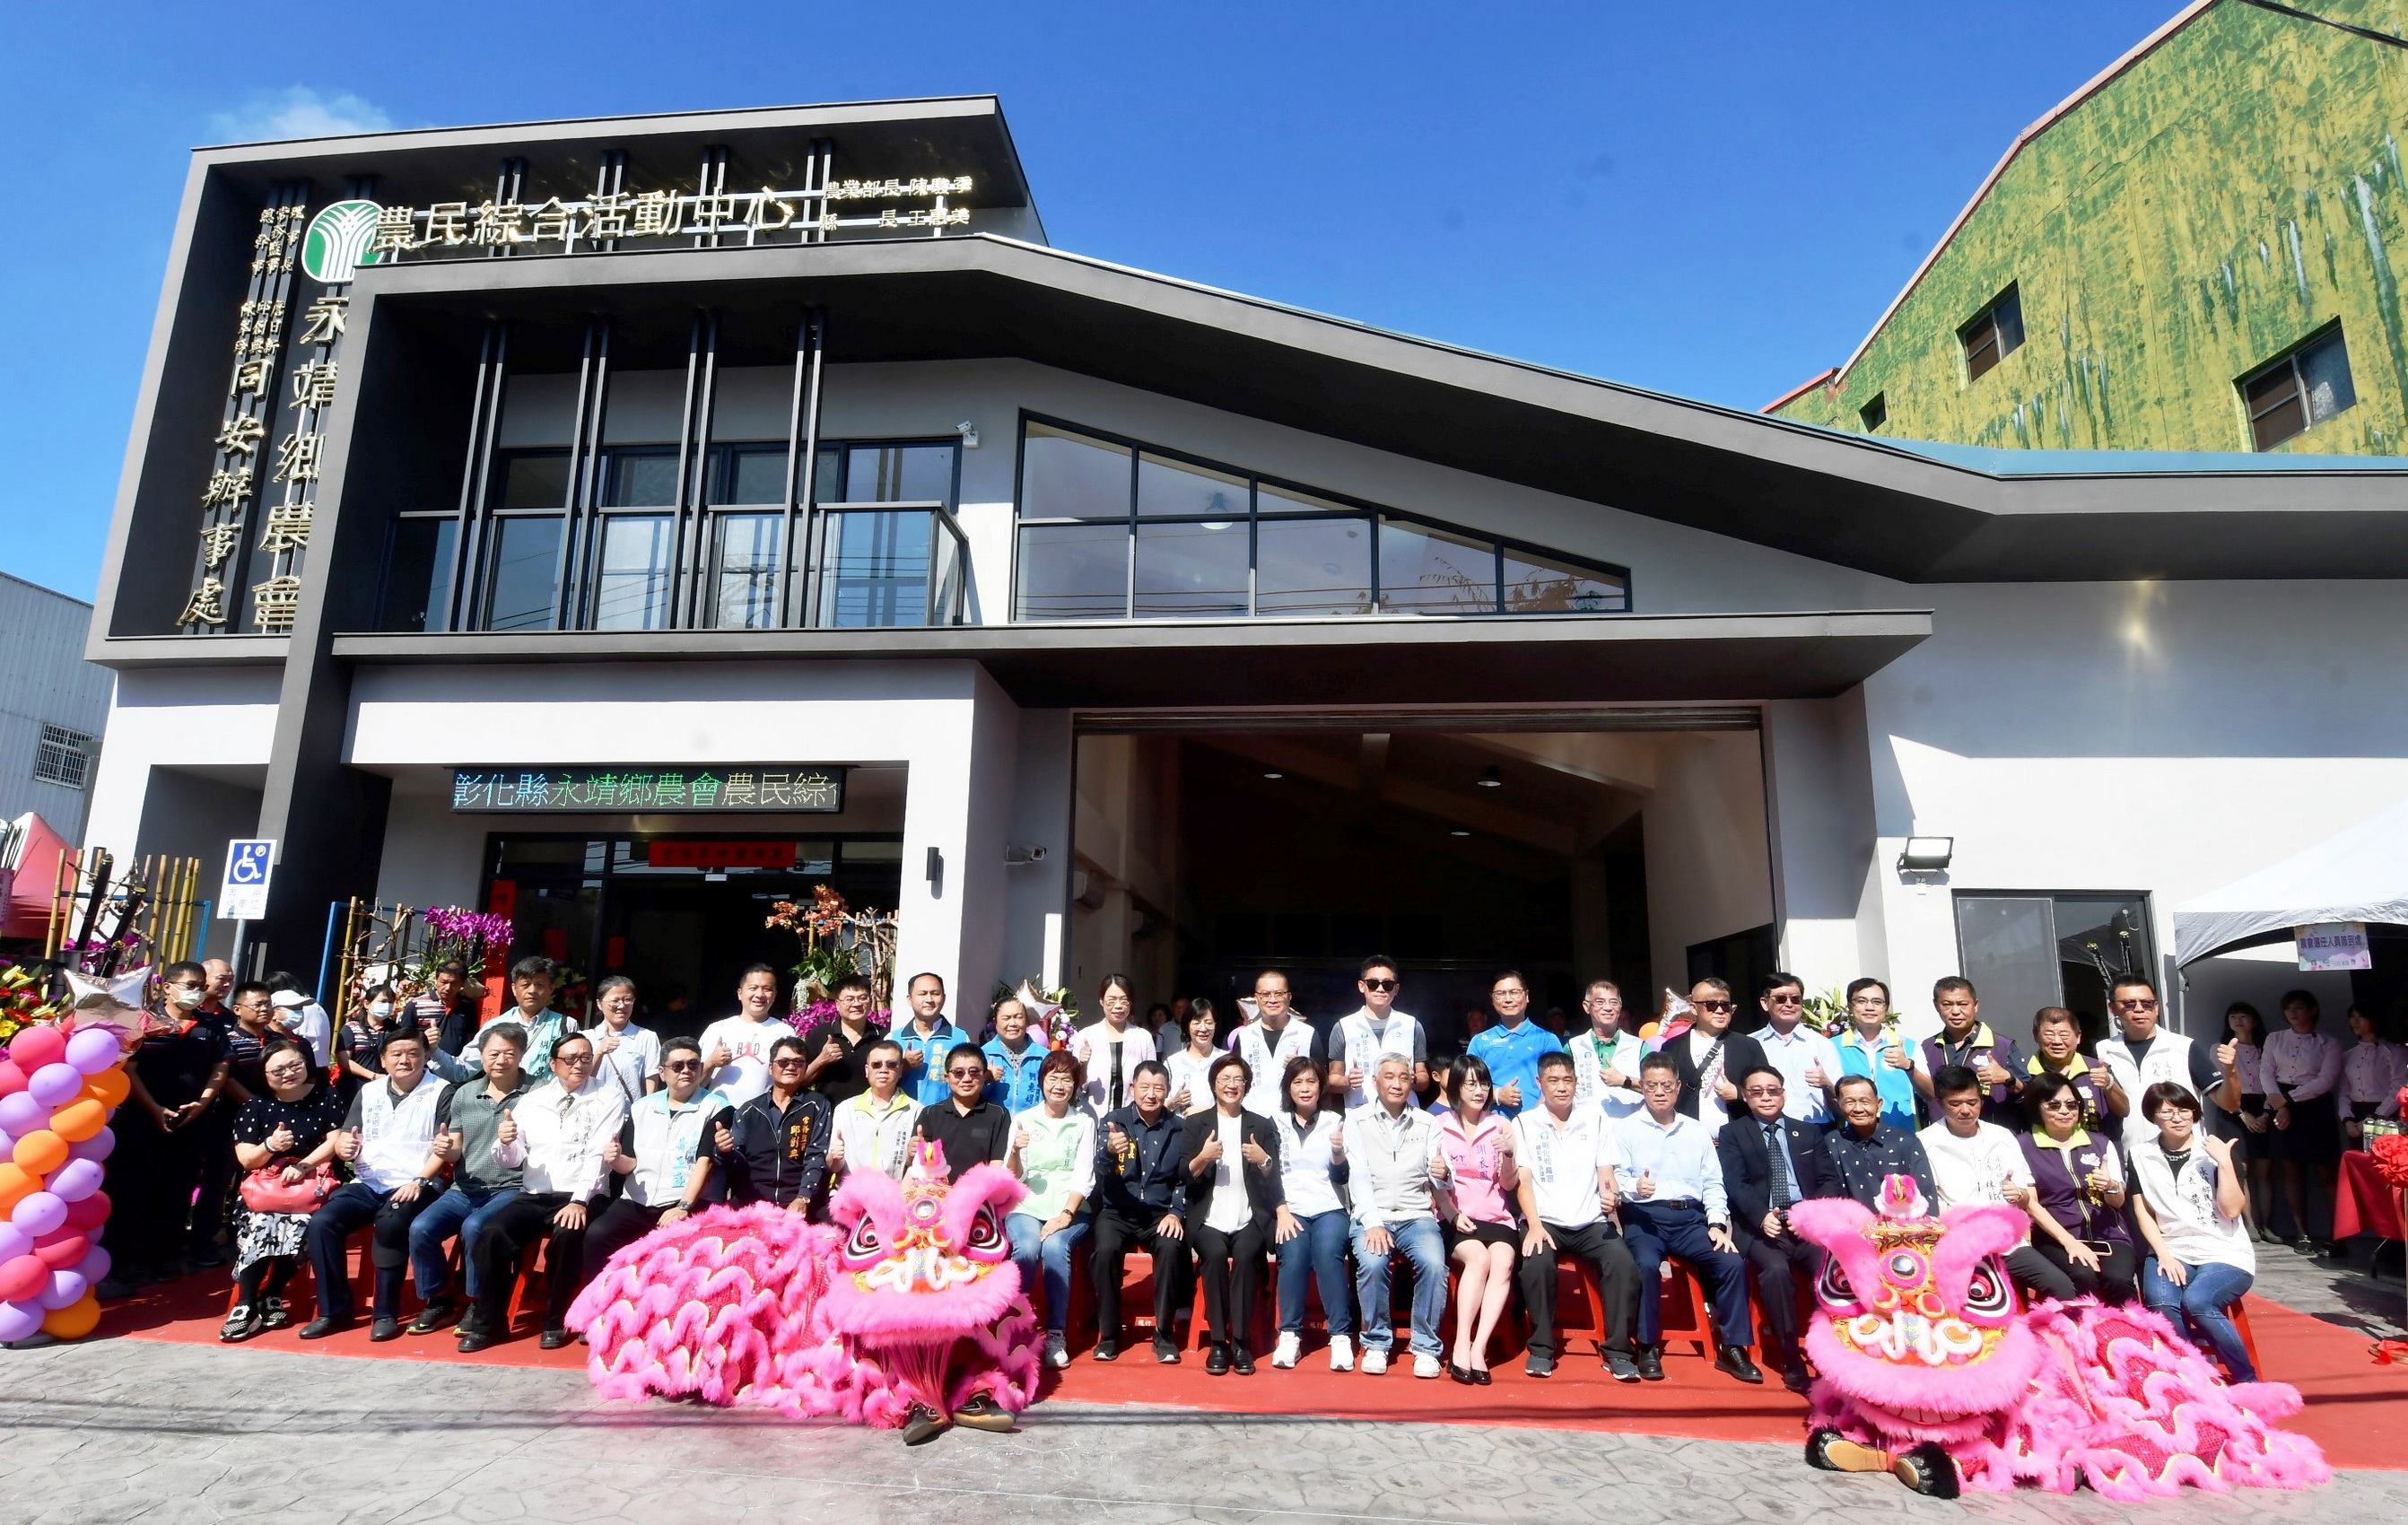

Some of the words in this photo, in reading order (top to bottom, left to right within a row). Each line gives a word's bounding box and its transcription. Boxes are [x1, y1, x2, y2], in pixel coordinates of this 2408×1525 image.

[366, 186, 795, 255] 農民綜合活動中心
[824, 179, 901, 200] 農業部長
[907, 207, 971, 226] 王惠美
[176, 359, 272, 627] 同安辦事處
[251, 296, 350, 627] 永靖鄉農會
